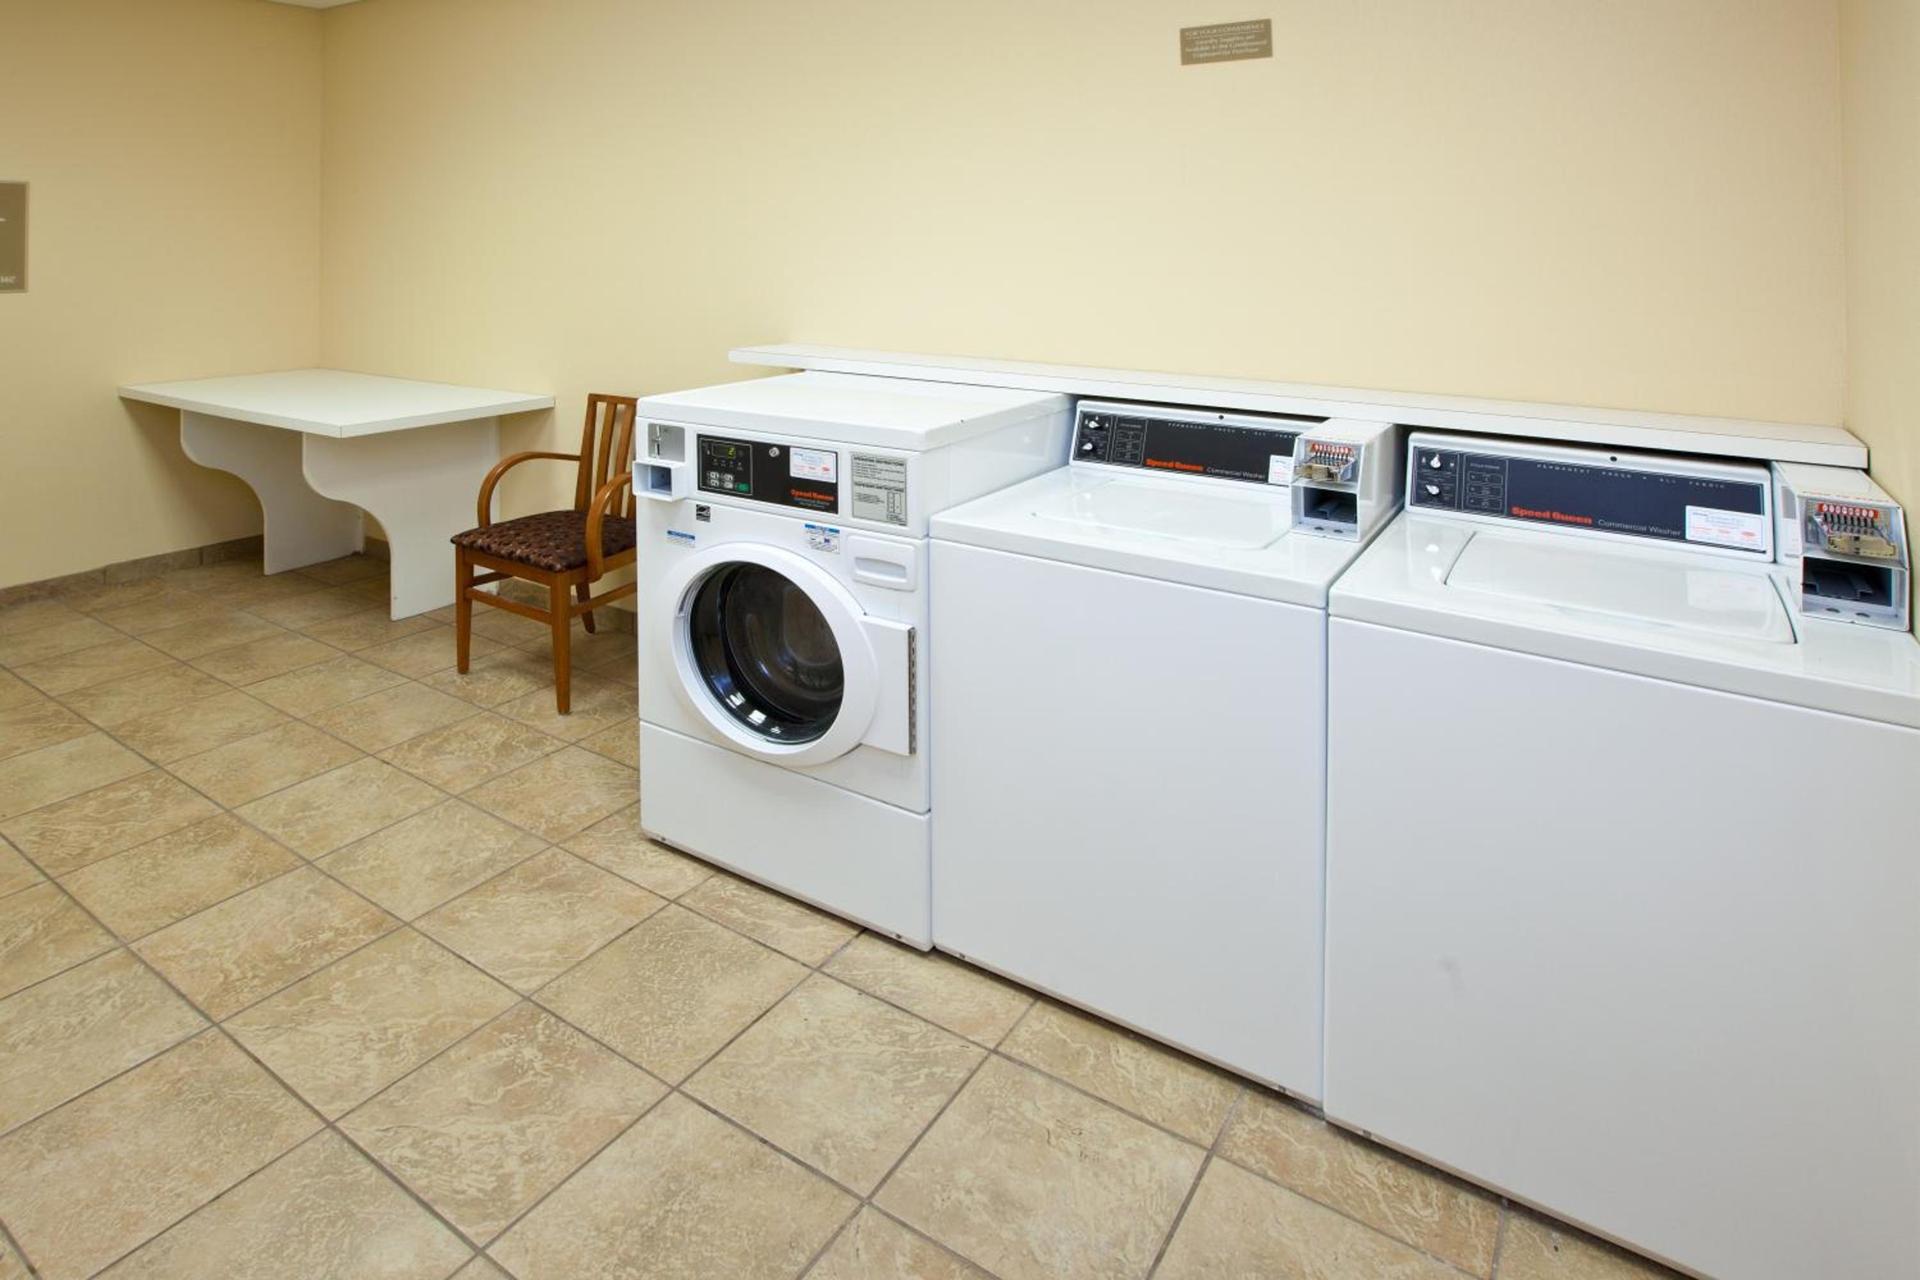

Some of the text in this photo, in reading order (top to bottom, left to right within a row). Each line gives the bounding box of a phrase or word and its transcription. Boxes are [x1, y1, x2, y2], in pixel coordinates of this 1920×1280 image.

[1145, 458, 1174, 469] Speed
[1175, 461, 1204, 473] Queen
[1206, 467, 1241, 477] Commercial
[1536, 463, 1591, 474] PERMANENT
[1511, 506, 1681, 537] Speed Queen Commercial Washer
